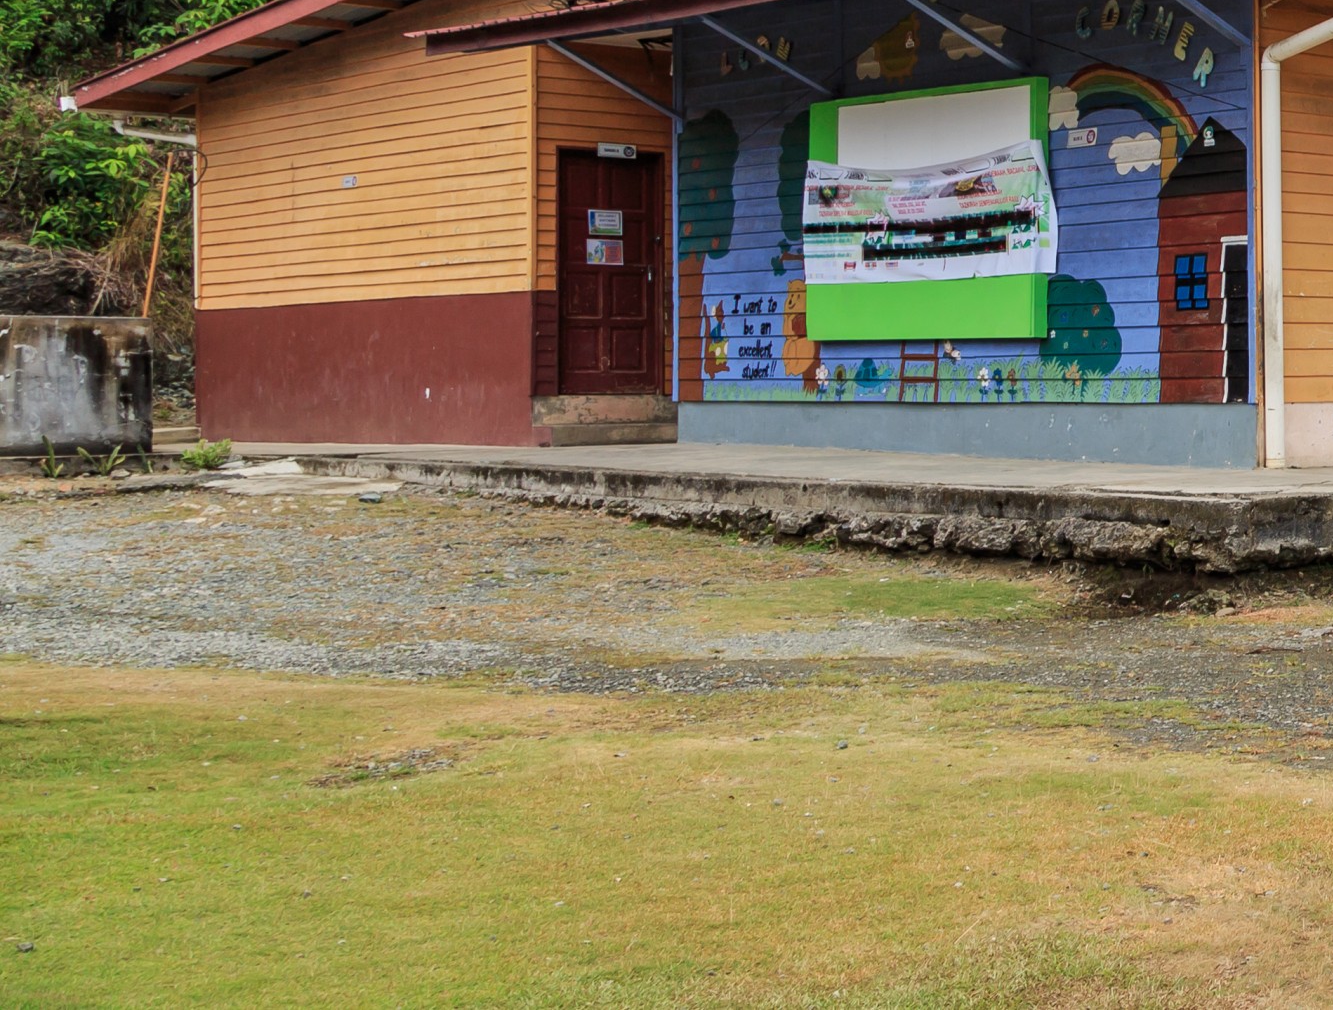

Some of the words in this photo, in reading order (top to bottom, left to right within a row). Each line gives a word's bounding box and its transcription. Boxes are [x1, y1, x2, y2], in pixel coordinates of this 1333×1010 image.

[732, 294, 741, 313] I
[743, 297, 763, 313] want
[768, 296, 777, 313] to
[743, 318, 754, 335] be
[760, 322, 771, 335] an
[738, 339, 773, 359] excellent
[742, 360, 777, 380] student!!
